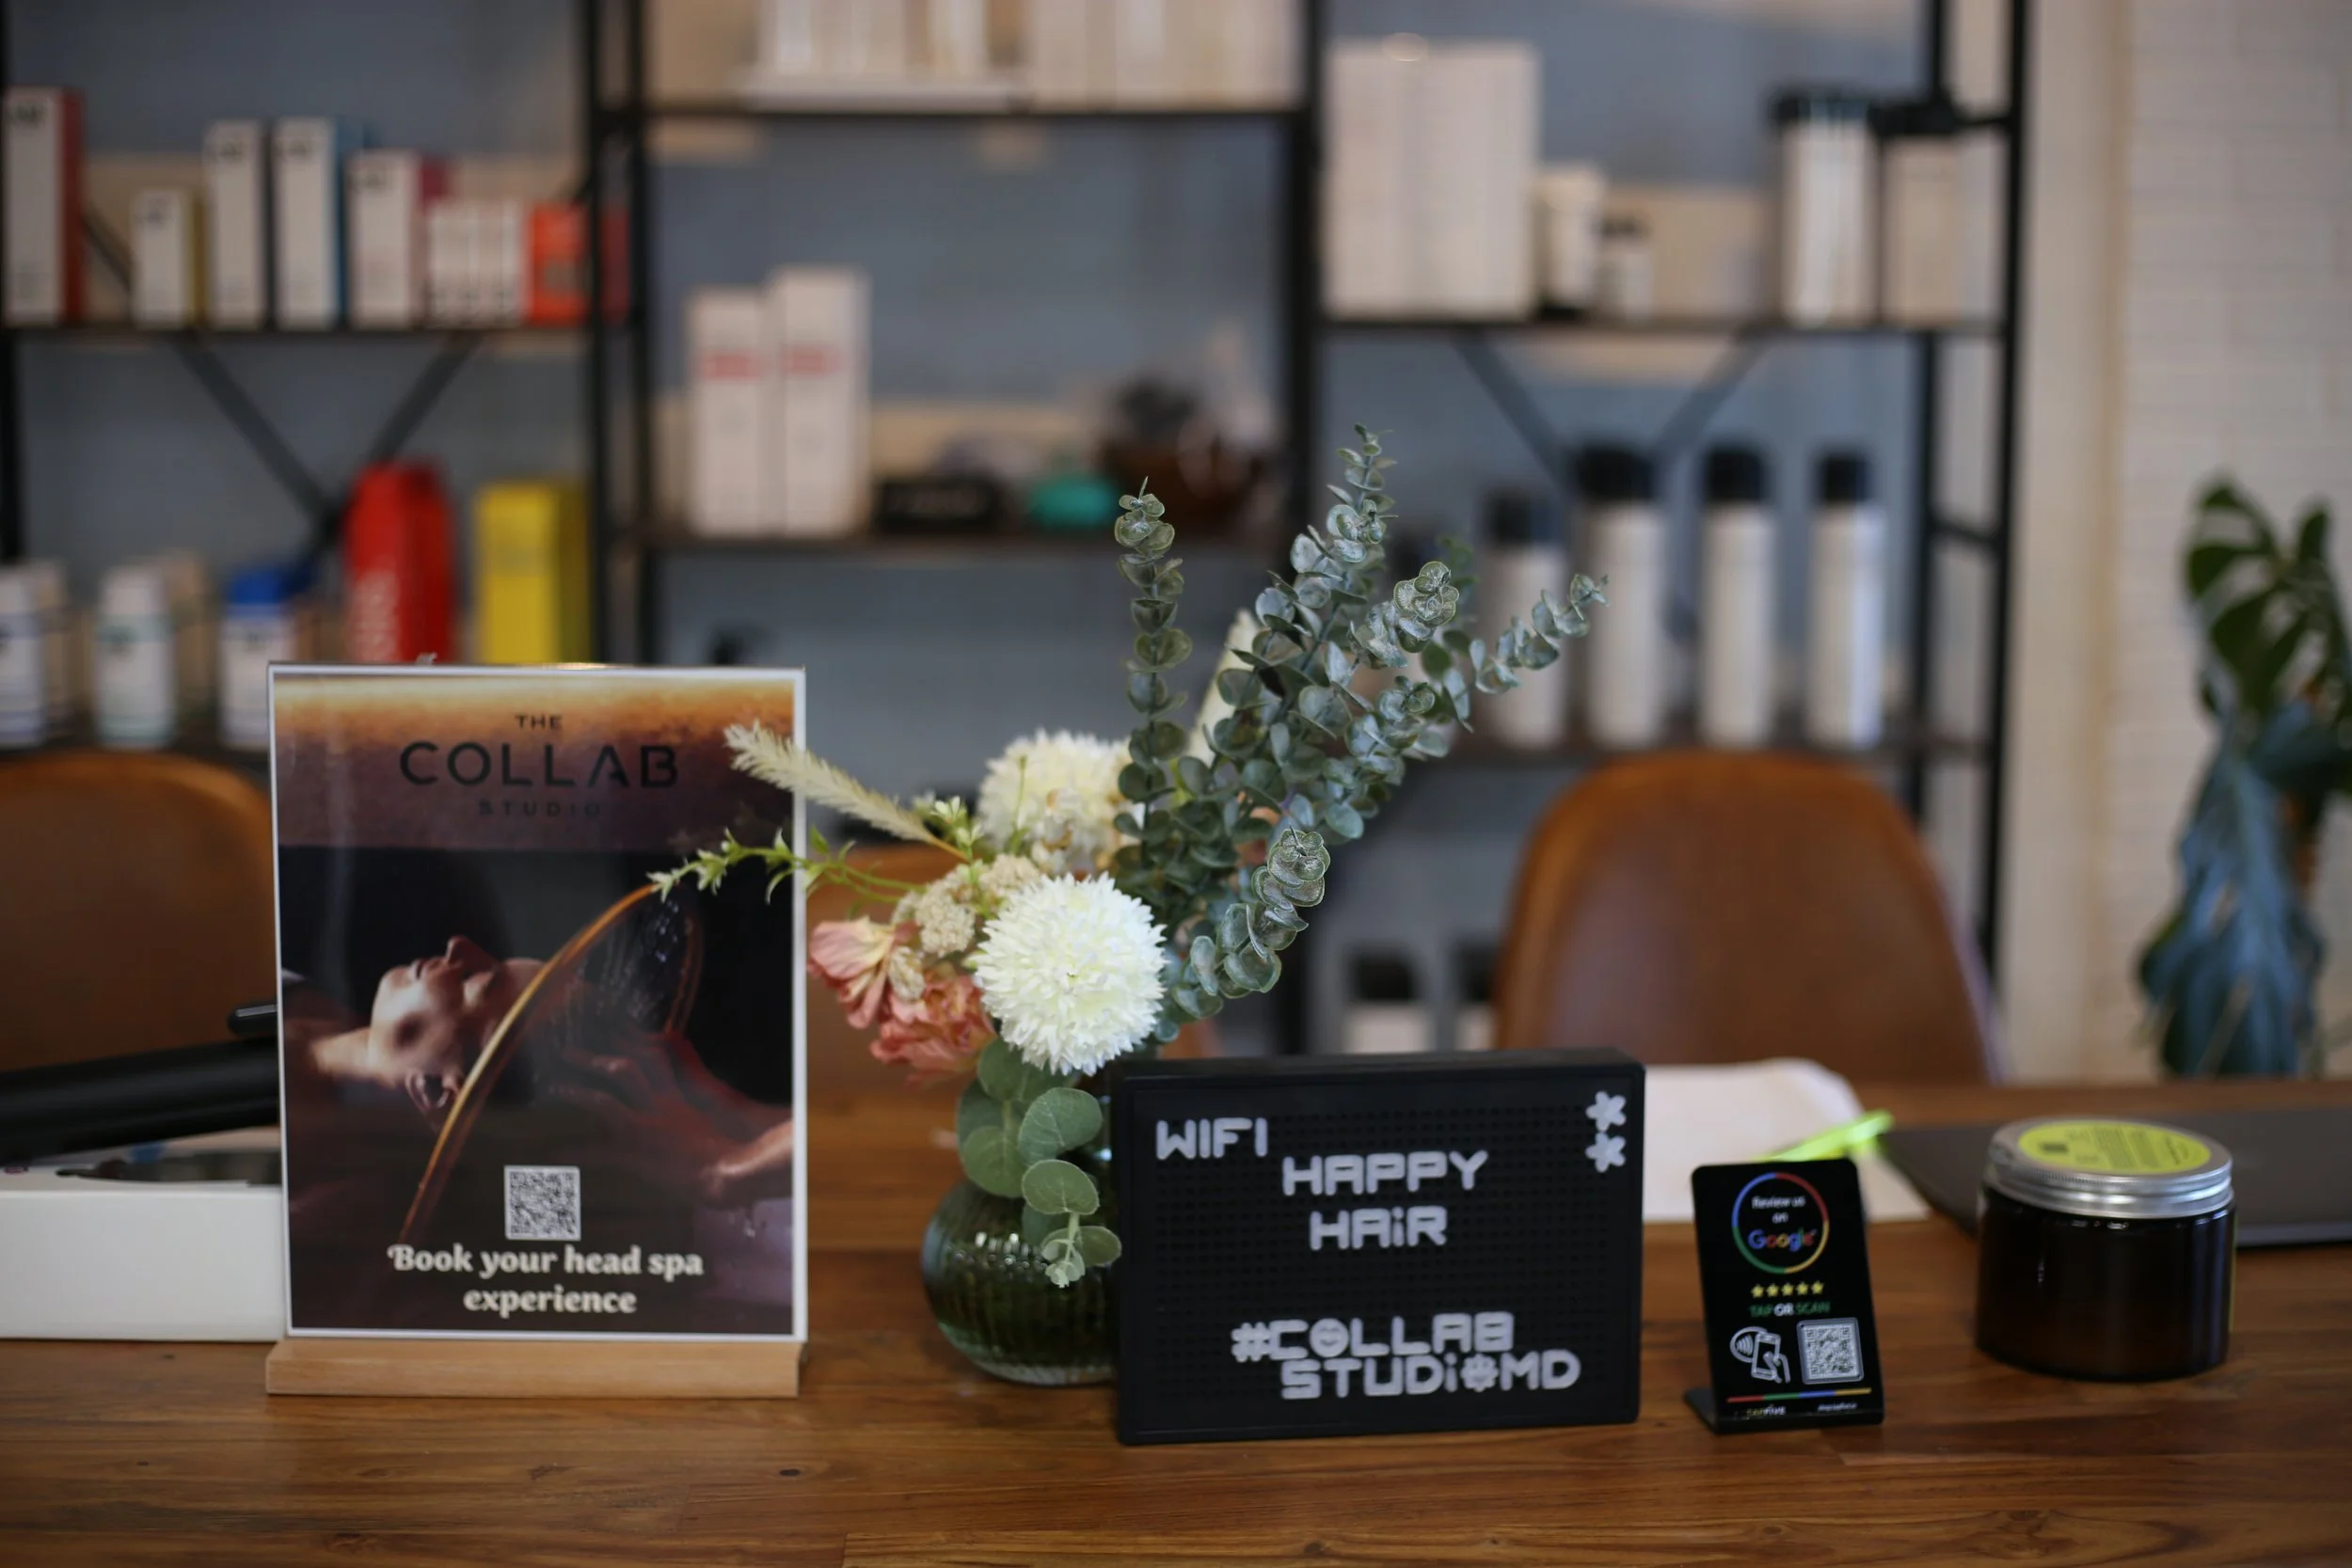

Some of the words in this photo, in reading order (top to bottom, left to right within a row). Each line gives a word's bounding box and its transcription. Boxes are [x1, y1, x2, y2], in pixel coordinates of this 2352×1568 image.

[516, 715, 563, 730] THE
[400, 741, 678, 788] COLLAB
[479, 800, 601, 817] STUDIO
[1156, 1117, 1268, 1161] WIFI
[1281, 1149, 1488, 1196] HAPPY
[1752, 1196, 1790, 1210] Review
[1791, 1196, 1805, 1208] us
[1772, 1212, 1788, 1224] on
[1748, 1227, 1814, 1252] Google
[388, 1243, 473, 1272] Book
[482, 1250, 558, 1279] your
[564, 1244, 642, 1275] head
[648, 1253, 704, 1283] spa
[464, 1284, 637, 1319] experience
[1773, 1303, 1794, 1317] OR
[1795, 1301, 1831, 1315] SCAN
